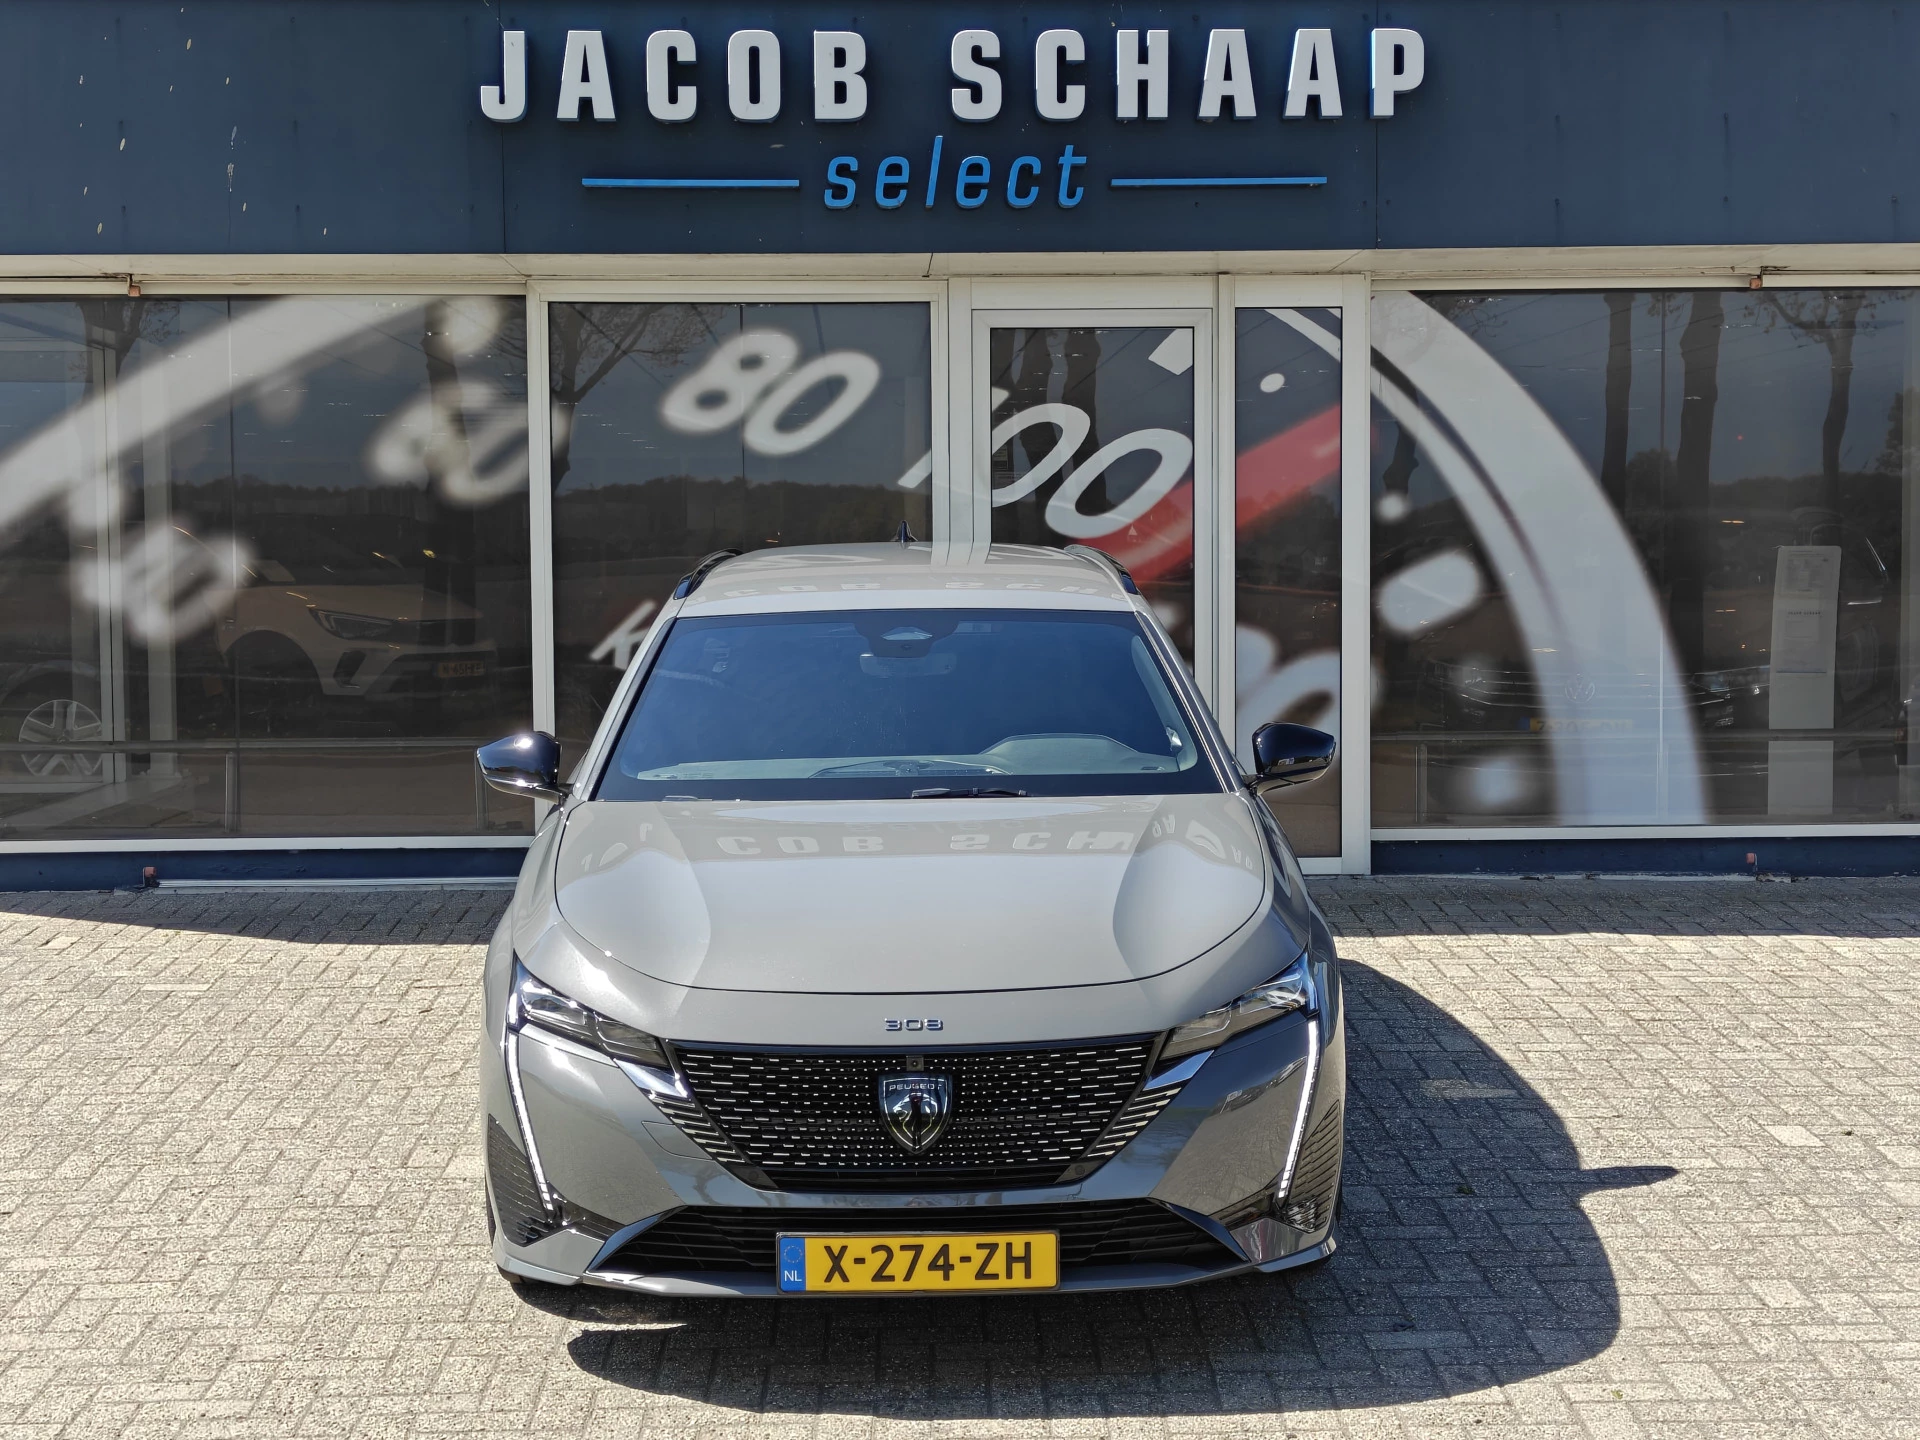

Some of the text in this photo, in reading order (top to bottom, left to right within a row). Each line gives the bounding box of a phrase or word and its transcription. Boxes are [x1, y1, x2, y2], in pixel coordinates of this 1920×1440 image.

[480, 28, 1425, 122] JACOB SCHAAP
[823, 135, 1088, 209] select
[661, 328, 881, 457] 80
[884, 1017, 944, 1031] 308
[784, 1270, 802, 1282] NL
[823, 1241, 1032, 1283] X-274-ZH
